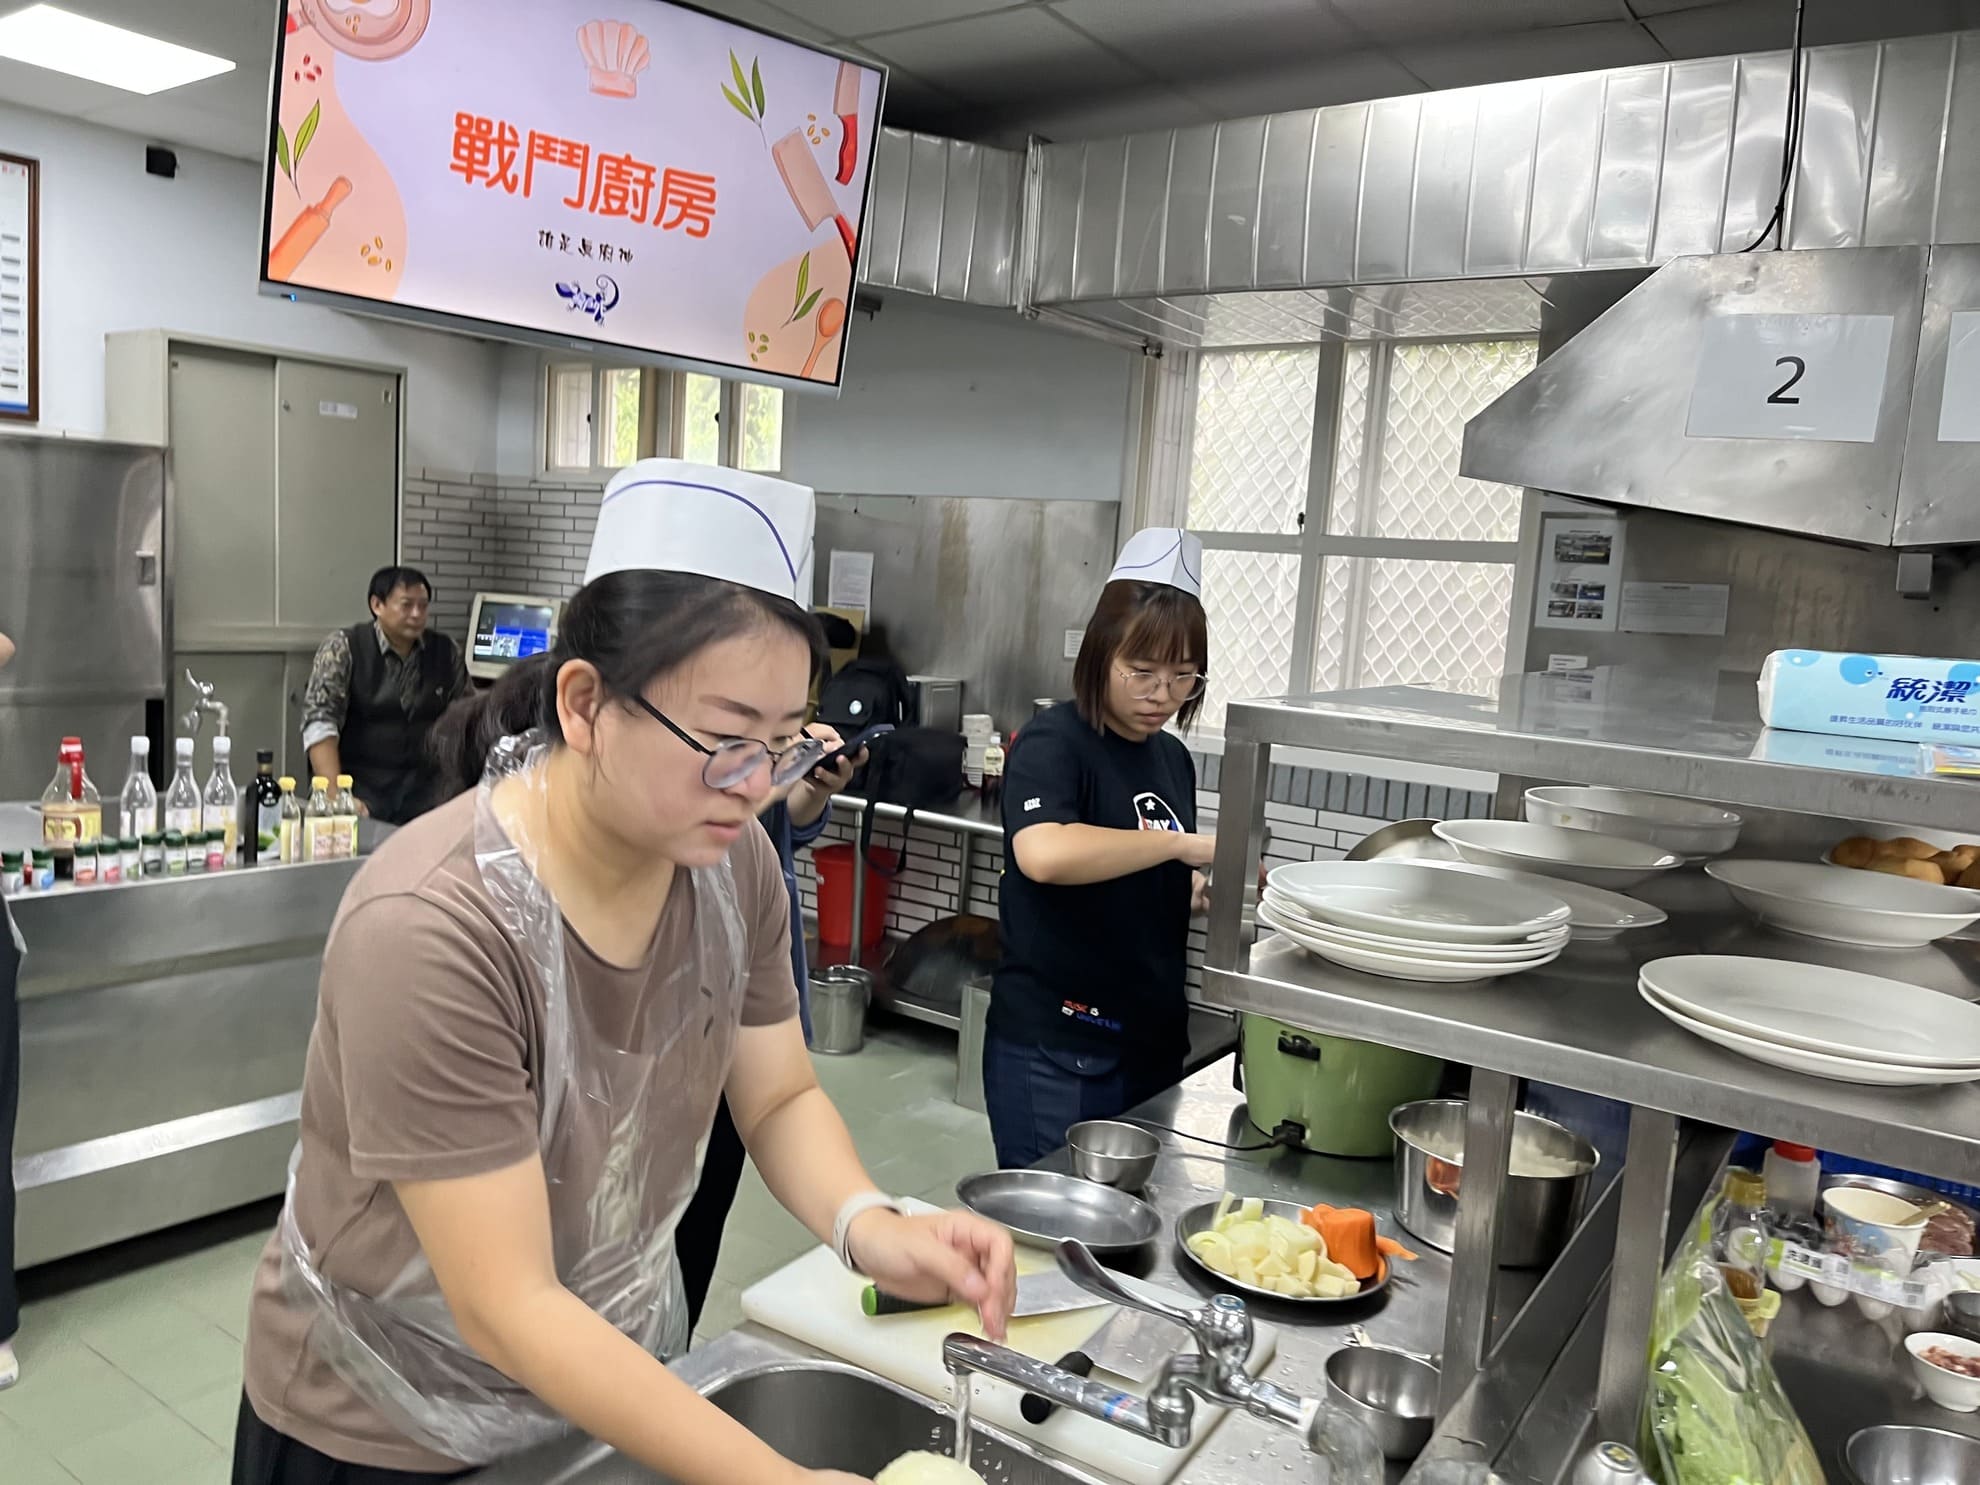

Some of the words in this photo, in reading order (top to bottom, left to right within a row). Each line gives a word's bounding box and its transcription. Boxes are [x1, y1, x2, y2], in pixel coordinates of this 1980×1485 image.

[449, 111, 717, 239] 戰鬥廚房
[1767, 355, 1805, 404] 2
[1886, 677, 1971, 703] 統潔
